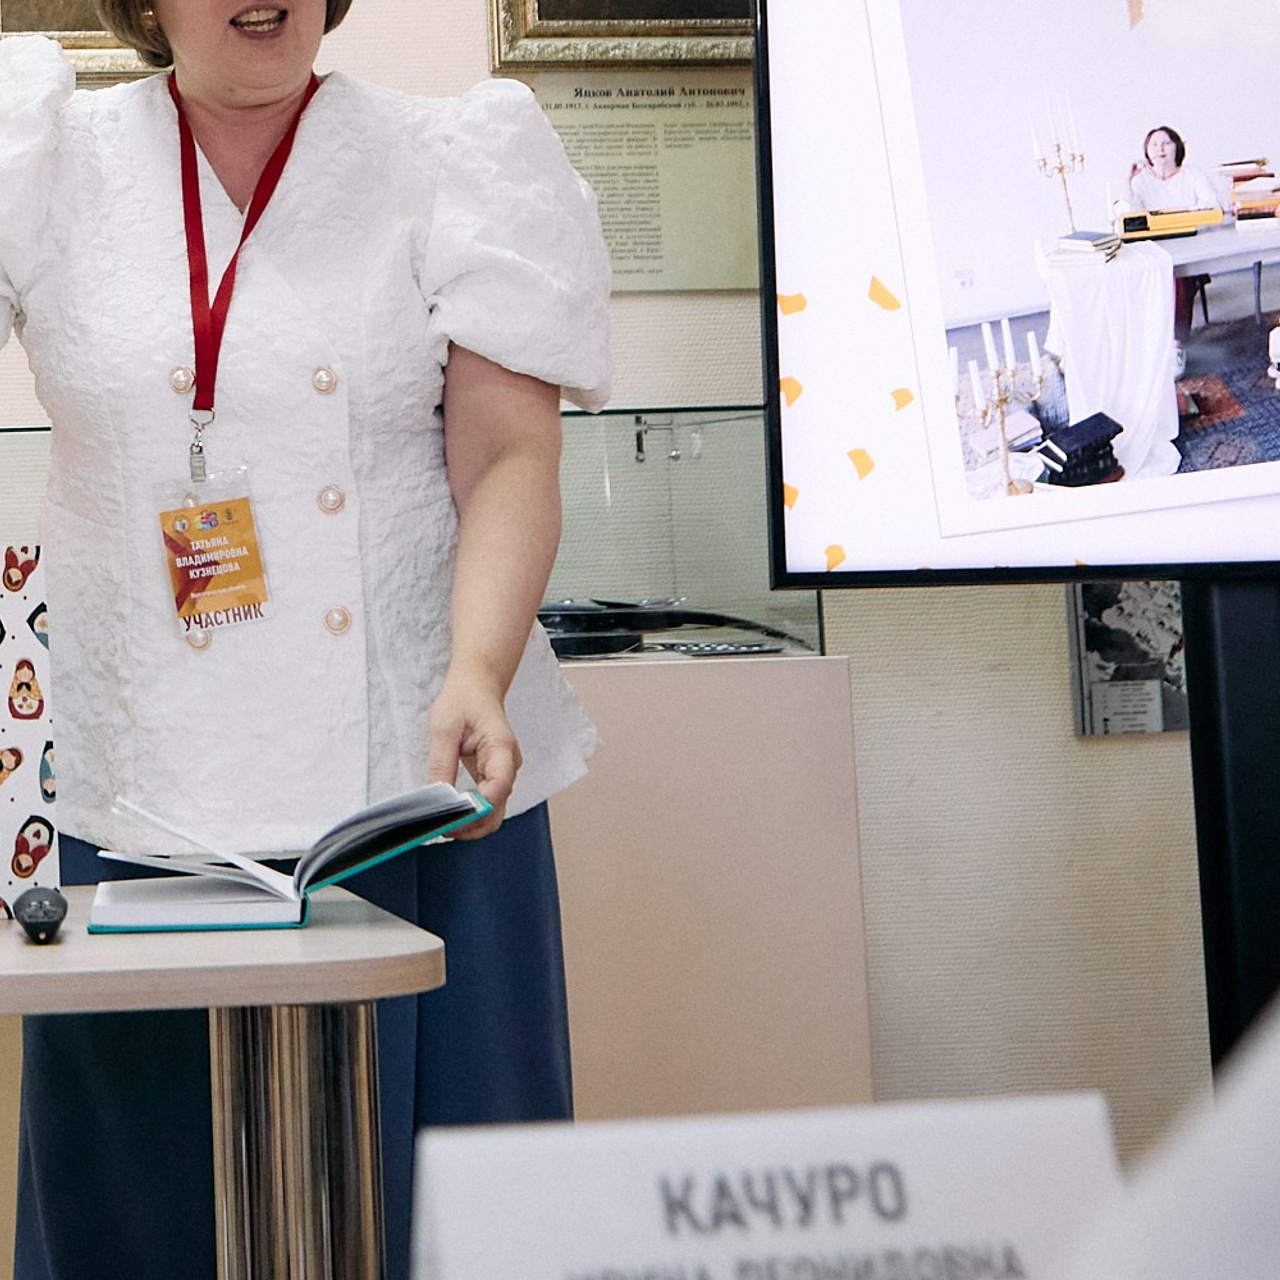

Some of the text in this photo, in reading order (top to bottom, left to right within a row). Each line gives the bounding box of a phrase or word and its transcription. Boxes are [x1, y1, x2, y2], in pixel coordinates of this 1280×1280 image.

[575, 85, 745, 98] Яцков Анатолий Антонович
[190, 536, 229, 551] ТАТЬЯНА
[175, 546, 249, 568] ВЛАДИМИРОВНА
[189, 561, 241, 579] КУЗНЕЦОВА
[182, 602, 265, 632] УЧАСТНИК
[658, 1157, 909, 1236] КАЧУРО
